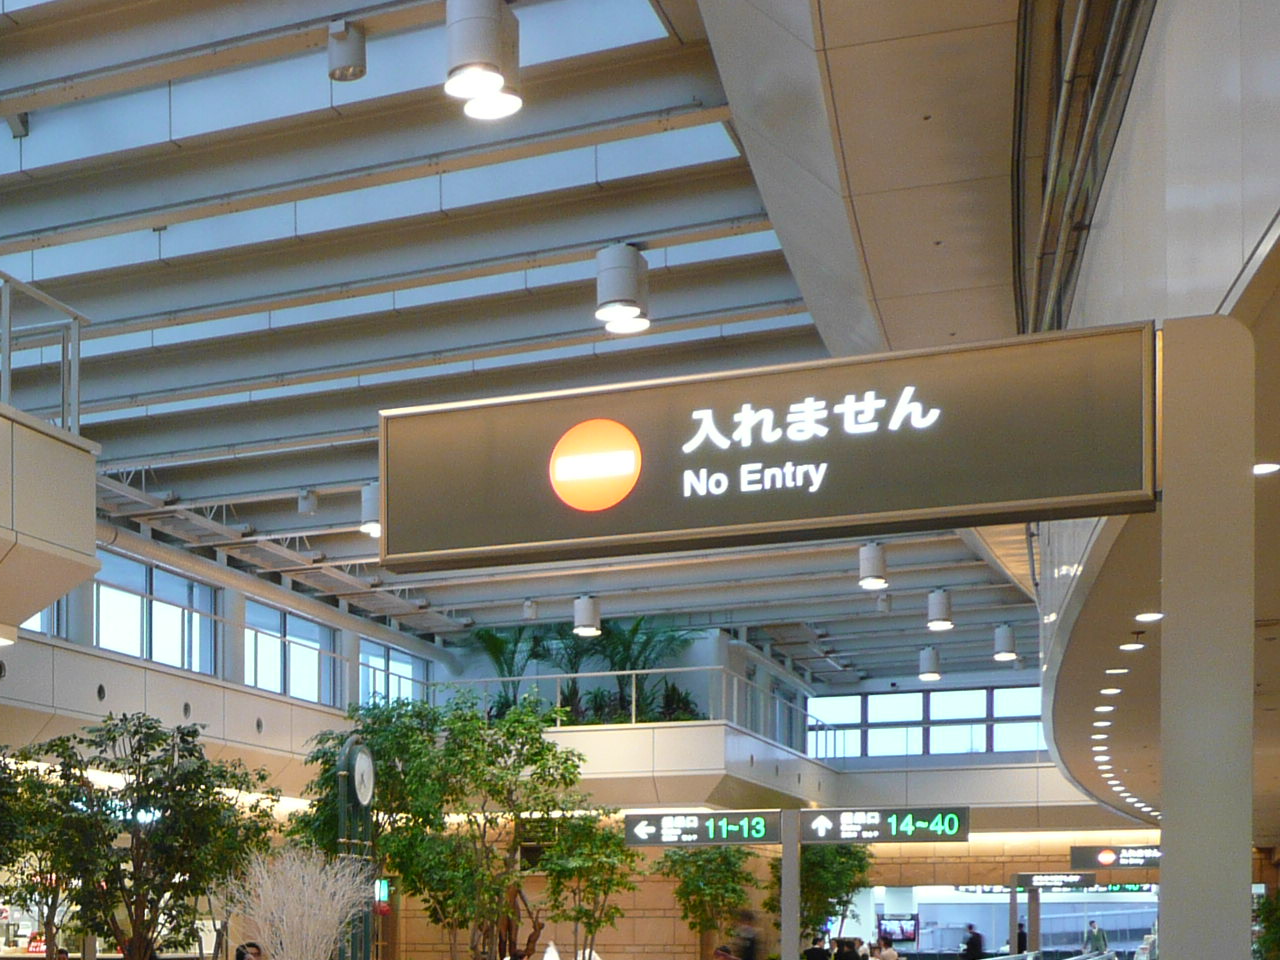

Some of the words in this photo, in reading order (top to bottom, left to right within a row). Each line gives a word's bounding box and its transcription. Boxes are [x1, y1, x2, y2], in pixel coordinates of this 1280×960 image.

[681, 385, 942, 454] 入れません
[682, 468, 728, 497] No
[740, 460, 828, 493] Entry
